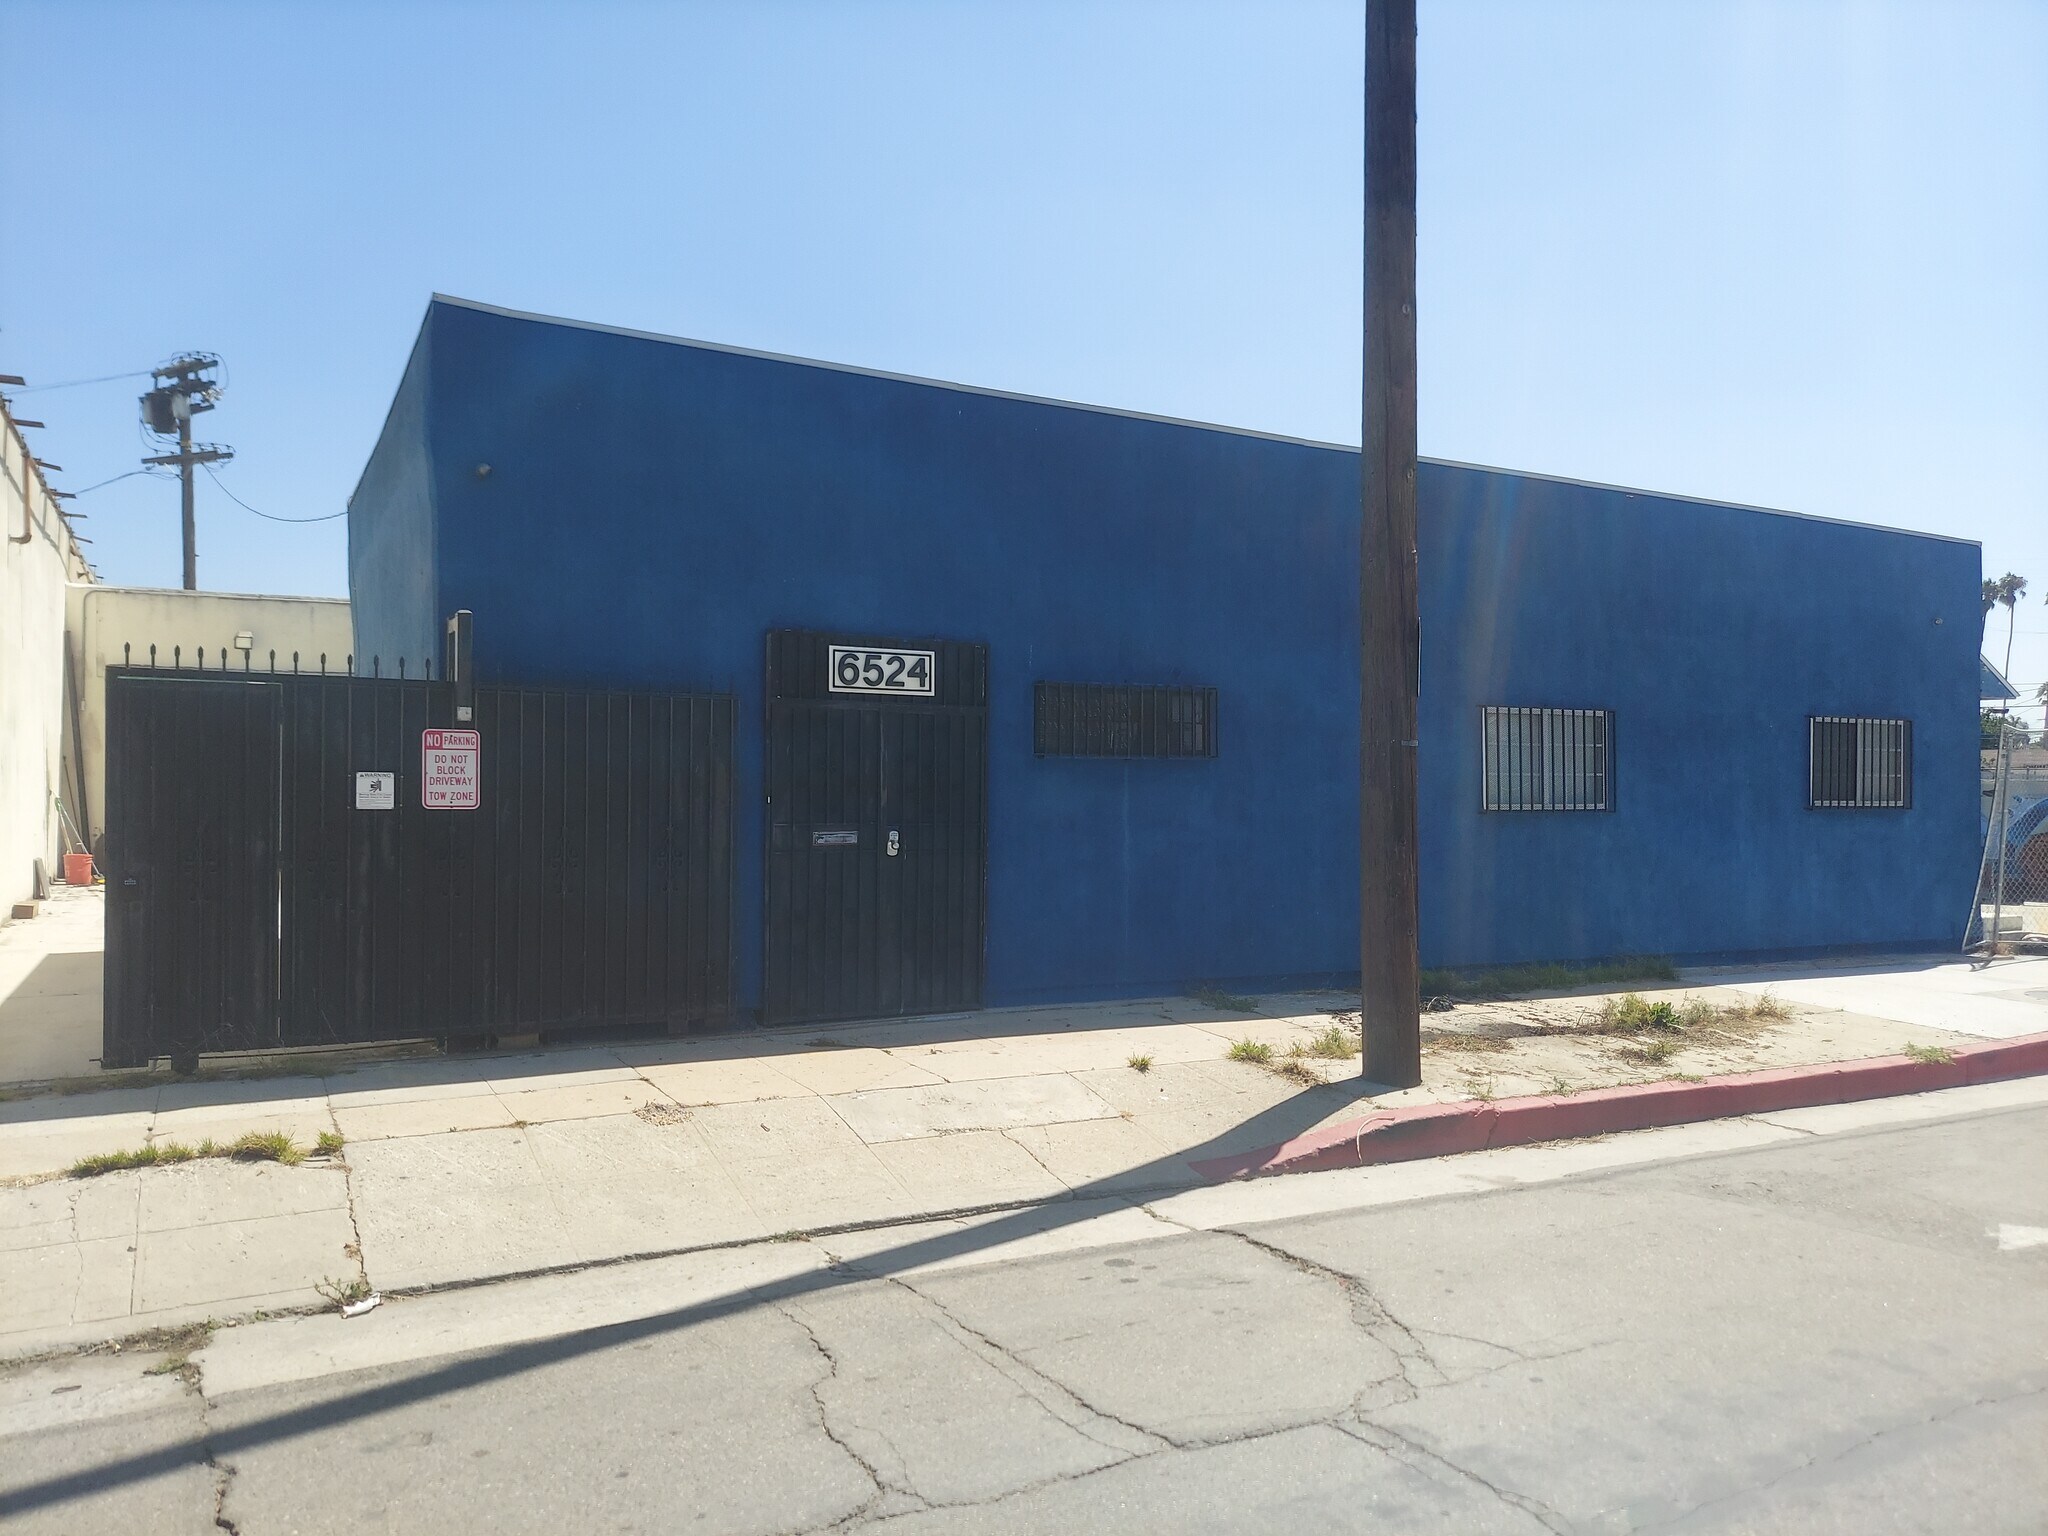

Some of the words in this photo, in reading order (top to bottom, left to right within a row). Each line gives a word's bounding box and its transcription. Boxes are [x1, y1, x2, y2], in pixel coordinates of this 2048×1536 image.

[838, 653, 928, 688] 6524
[427, 734, 440, 746] NO
[444, 736, 475, 745] PARKING
[435, 755, 446, 763] DO
[451, 755, 468, 763] NOT
[437, 766, 466, 774] BLOCK
[429, 777, 473, 785] DRIVEWAY
[429, 792, 447, 800] TOW
[450, 792, 474, 800] ZONE
